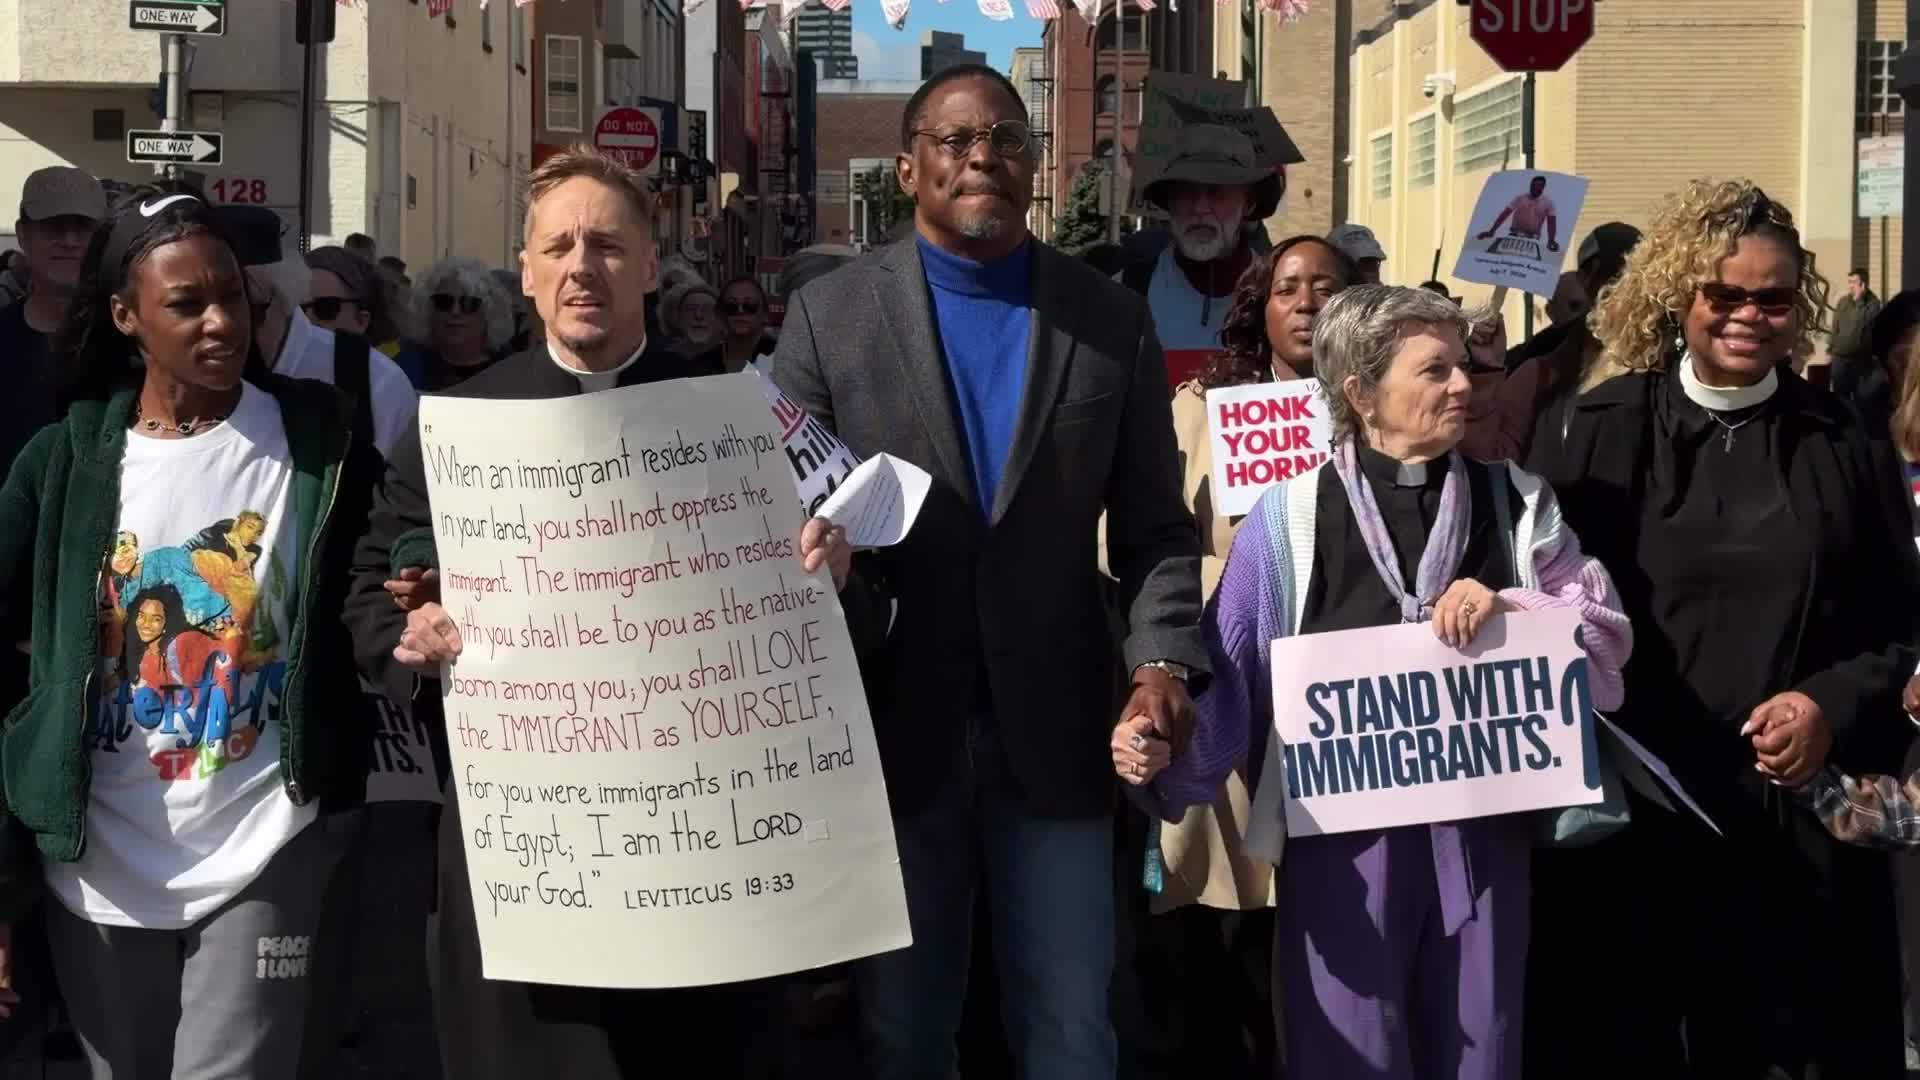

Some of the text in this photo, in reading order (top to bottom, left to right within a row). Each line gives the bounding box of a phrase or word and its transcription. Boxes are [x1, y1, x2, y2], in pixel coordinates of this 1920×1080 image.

[139, 10, 195, 24] ONE WAY
[1480, 0, 1585, 32] STOP
[137, 140, 193, 154] ONE WAY
[603, 120, 649, 132] DO NOT
[212, 178, 267, 204] 128
[1219, 394, 1316, 428] HONK
[1221, 425, 1314, 457] YOUR
[489, 464, 514, 490] an
[517, 437, 631, 498] immigrant
[641, 428, 708, 474] resides
[712, 423, 748, 461] with
[748, 432, 776, 471] you
[440, 475, 774, 553] in your land, you shall not oppress the
[448, 513, 793, 602] immigrant. The immigrant who resides
[485, 624, 516, 664] you
[520, 612, 569, 649] shall
[574, 611, 609, 646] be
[612, 604, 639, 644] to
[644, 615, 687, 654] you
[693, 609, 717, 633] as
[720, 586, 758, 625] the
[760, 572, 825, 617] native-
[452, 620, 828, 716] born among you; you shall LOVE
[1305, 655, 1554, 740] STAND WITH
[457, 711, 493, 751] the
[497, 711, 644, 753] IMMIGRANT
[653, 726, 680, 747] as
[680, 674, 835, 743] YOURSELF,
[465, 723, 855, 817] for you were immigrants in the land
[1284, 713, 1563, 800] IMMIGRANTS.
[474, 797, 803, 868] of Egypt; I am the LORD
[485, 880, 531, 918] your
[624, 882, 733, 910] LEVITICUS
[745, 872, 795, 897] 19:33
